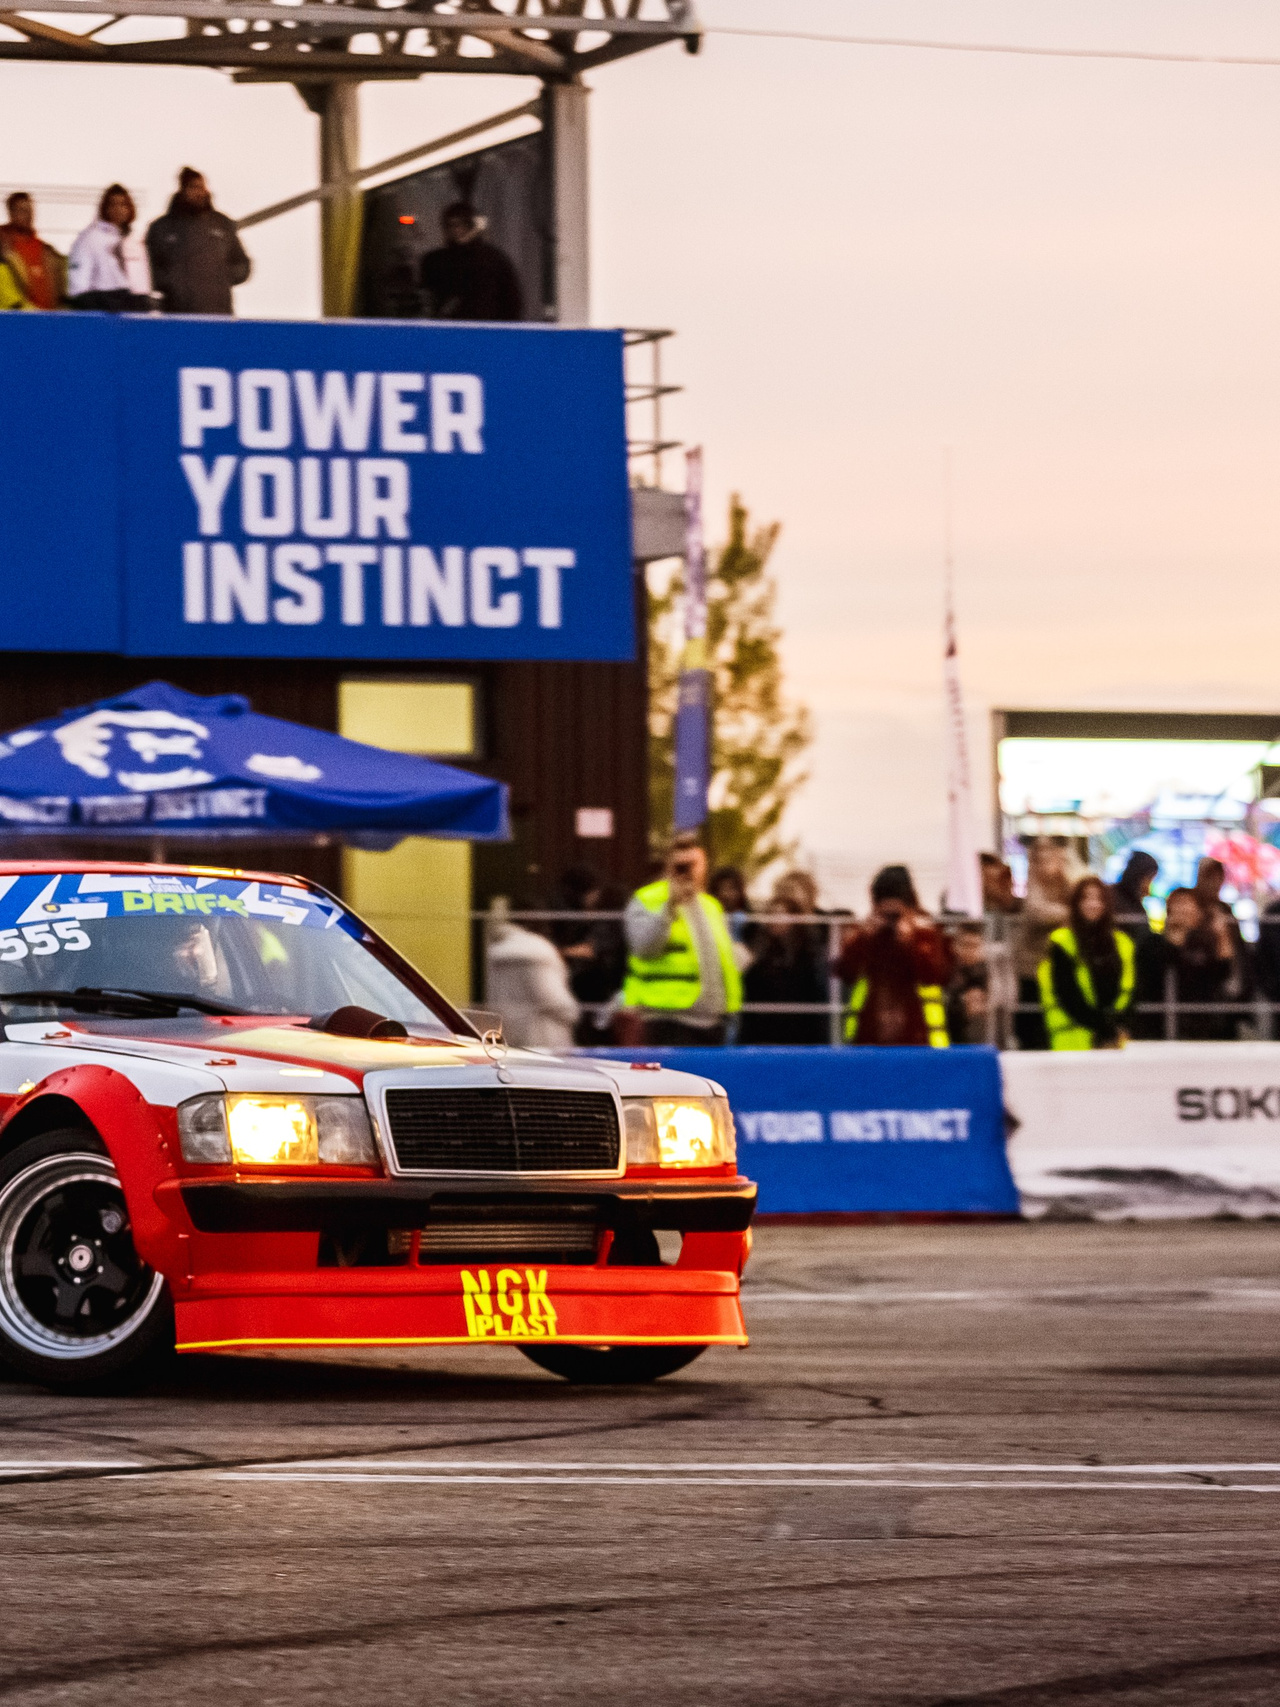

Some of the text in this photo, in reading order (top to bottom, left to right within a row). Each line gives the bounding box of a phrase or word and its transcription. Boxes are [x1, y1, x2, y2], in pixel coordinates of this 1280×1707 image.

[179, 367, 485, 454] POWER
[179, 454, 411, 540] YOUR
[183, 542, 577, 629] INSTINCT
[122, 891, 250, 918] DRIFT
[738, 1109, 970, 1143] YOUR INSTINCT
[1175, 1086, 1280, 1121] SOK
[460, 1268, 557, 1336] NGK
[476, 1314, 558, 1336] PLAST
